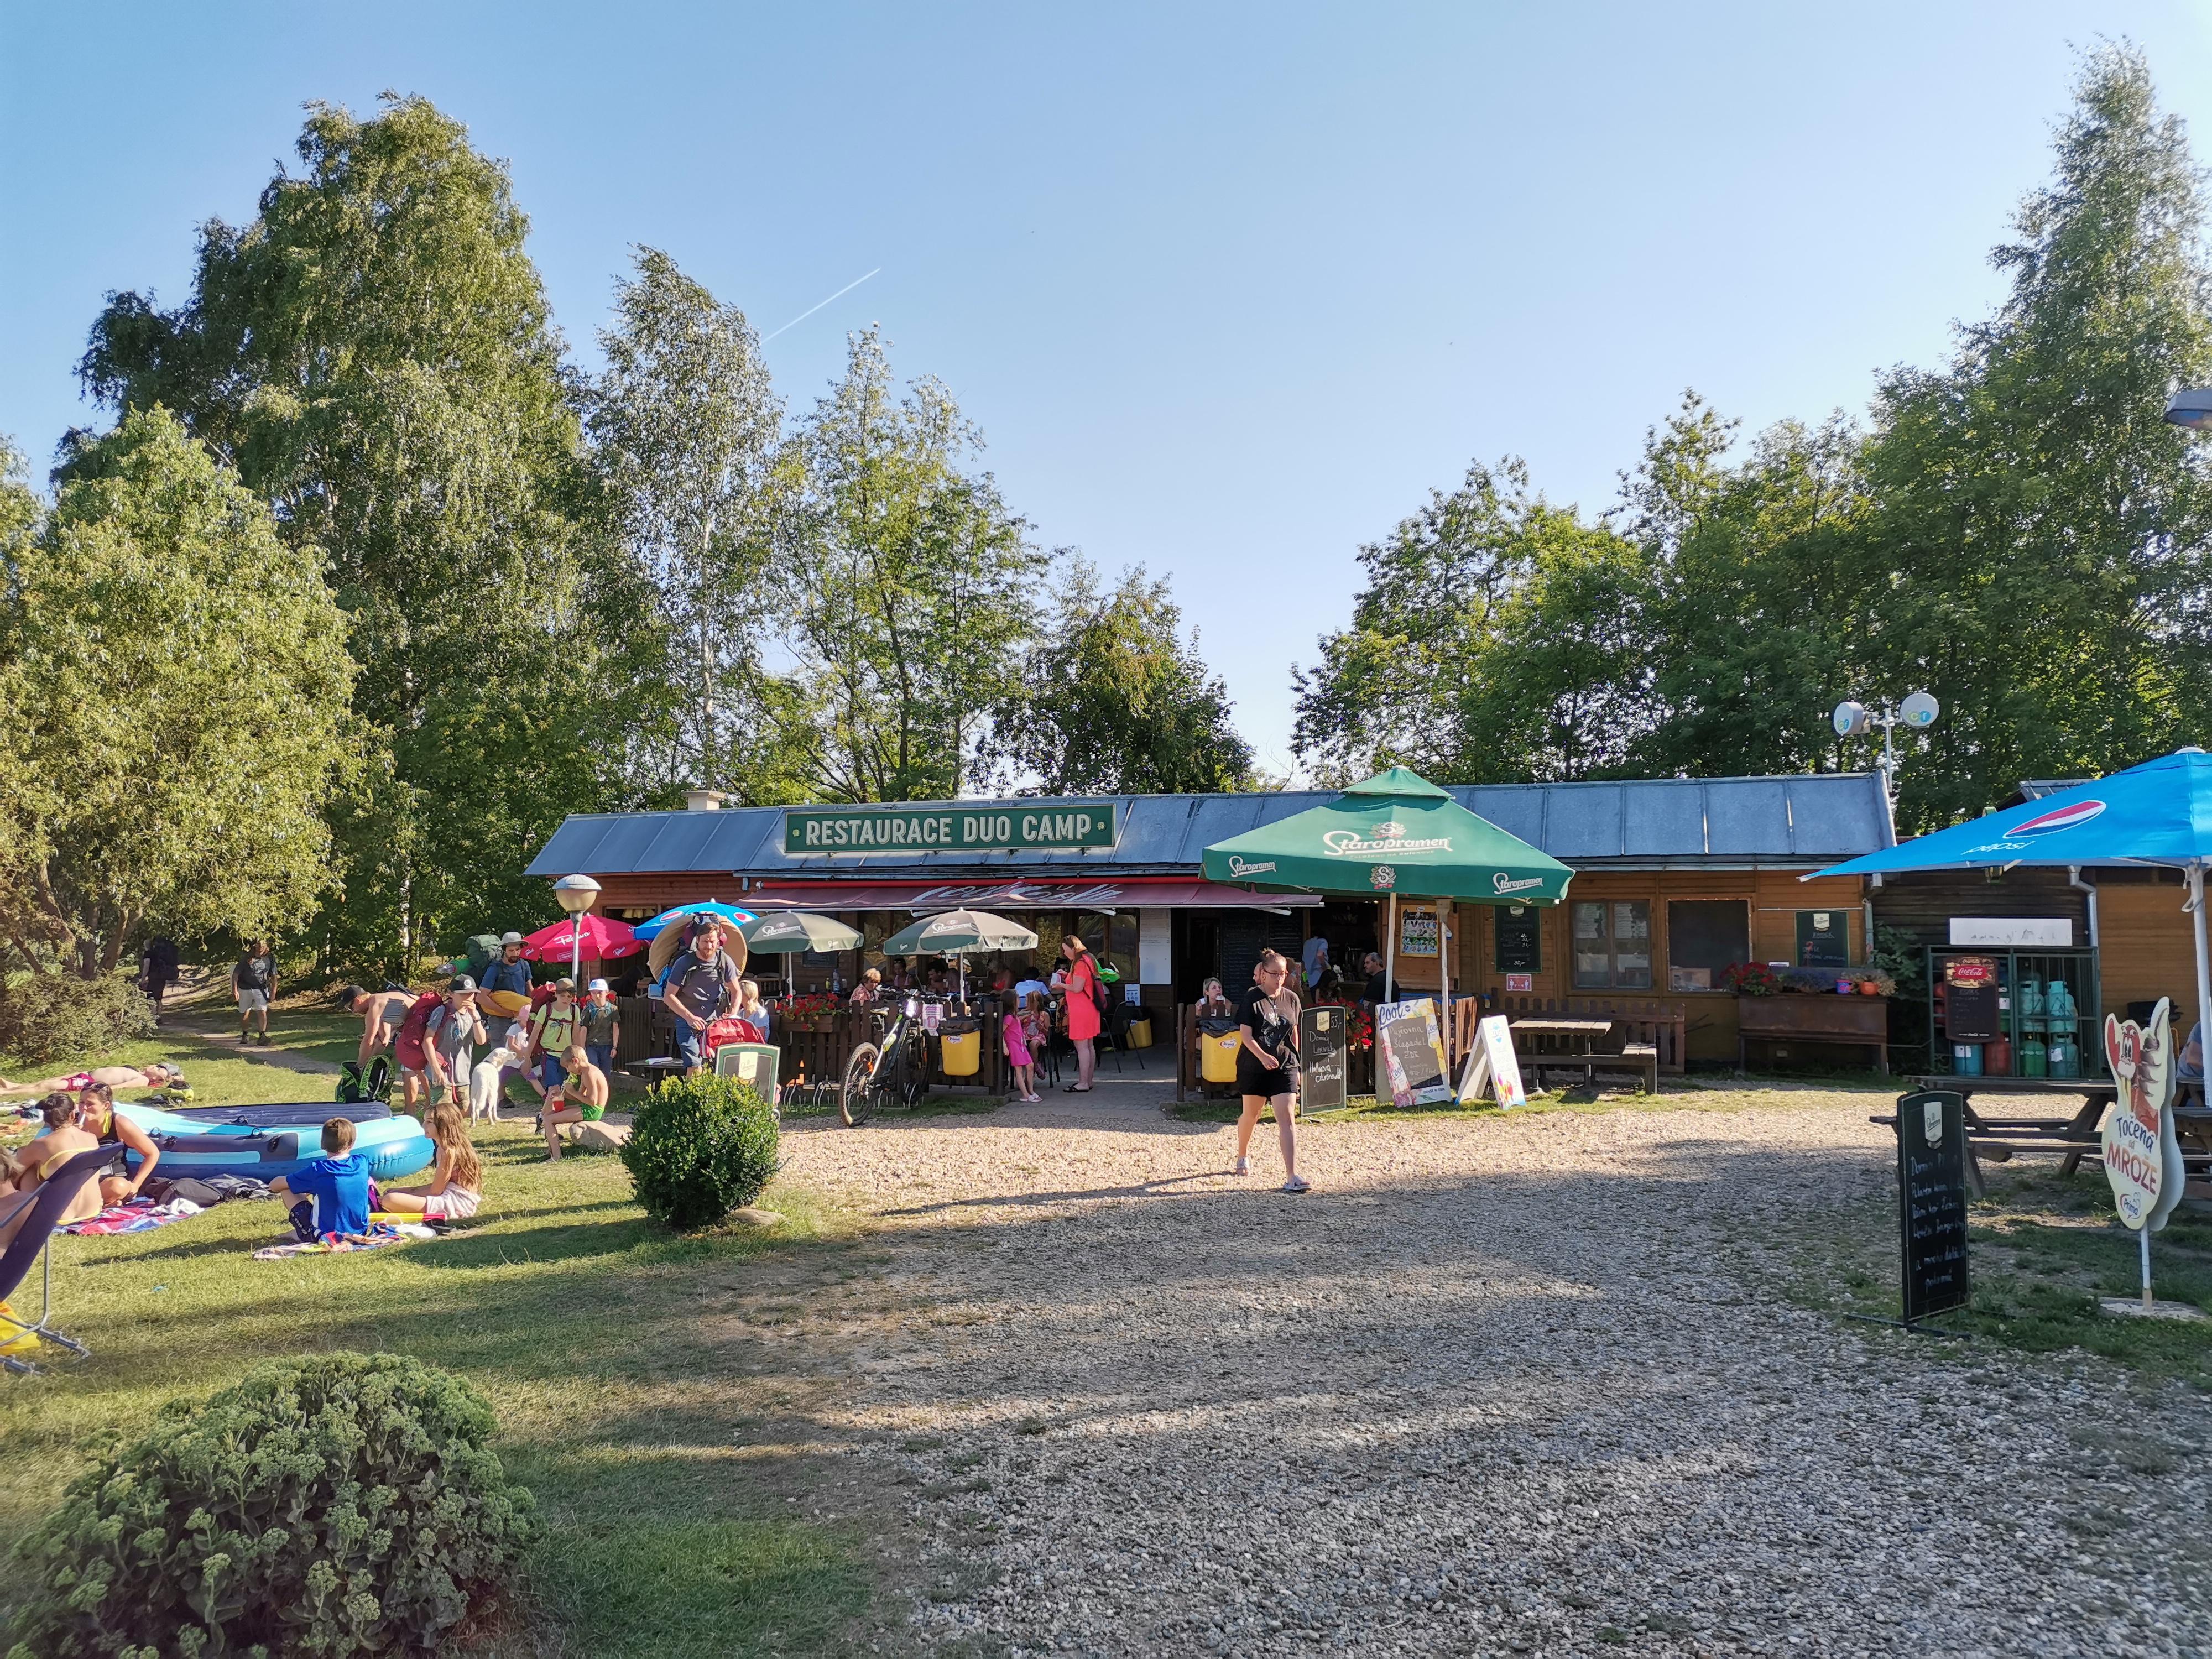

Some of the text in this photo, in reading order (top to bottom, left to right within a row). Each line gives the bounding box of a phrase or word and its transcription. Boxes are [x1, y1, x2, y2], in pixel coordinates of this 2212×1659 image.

[806, 813, 1092, 846] RESTAURACE DUO CAMP
[1323, 831, 1453, 855] Staropramen
[1229, 855, 1277, 878] Staropramen
[1493, 872, 1544, 895] Staropramen
[1379, 1001, 1404, 1025] Cool
[2116, 1114, 2154, 1154] Točená
[2107, 1140, 2158, 1196] MROŽE
